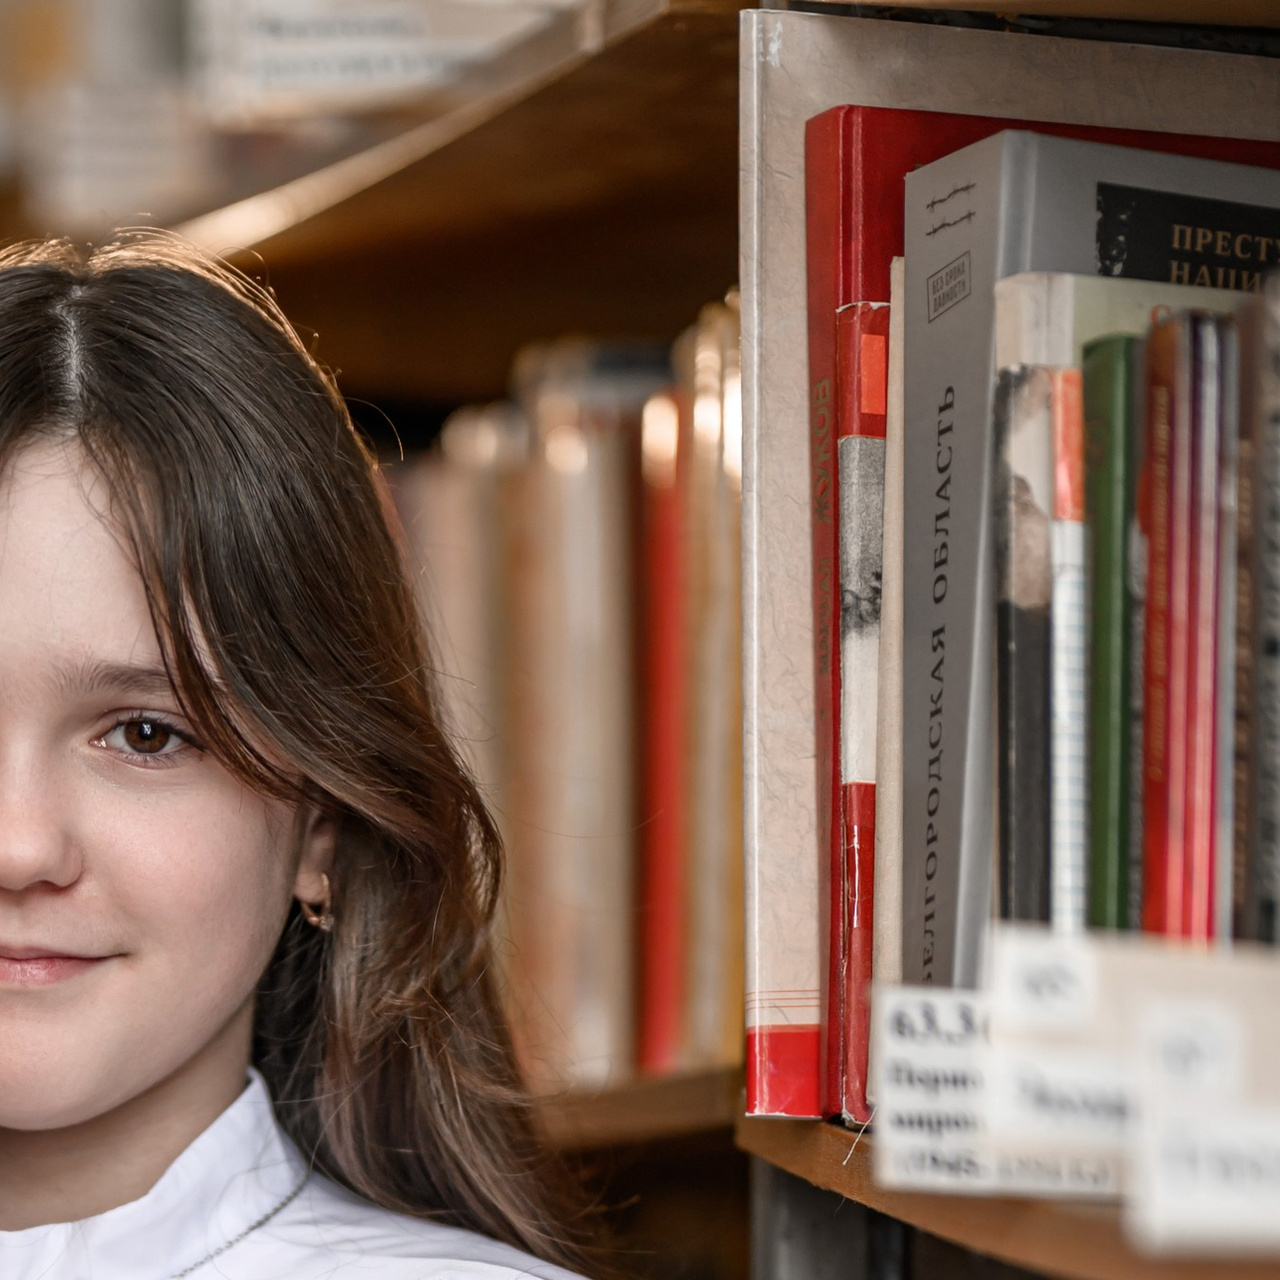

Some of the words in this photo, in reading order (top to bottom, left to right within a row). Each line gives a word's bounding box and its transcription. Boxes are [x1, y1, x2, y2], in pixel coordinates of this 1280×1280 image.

[1171, 223, 1280, 263] ПРЕСТ
[813, 378, 831, 524] ЖУКОВ
[932, 385, 956, 605] ОБЛАСТЬ
